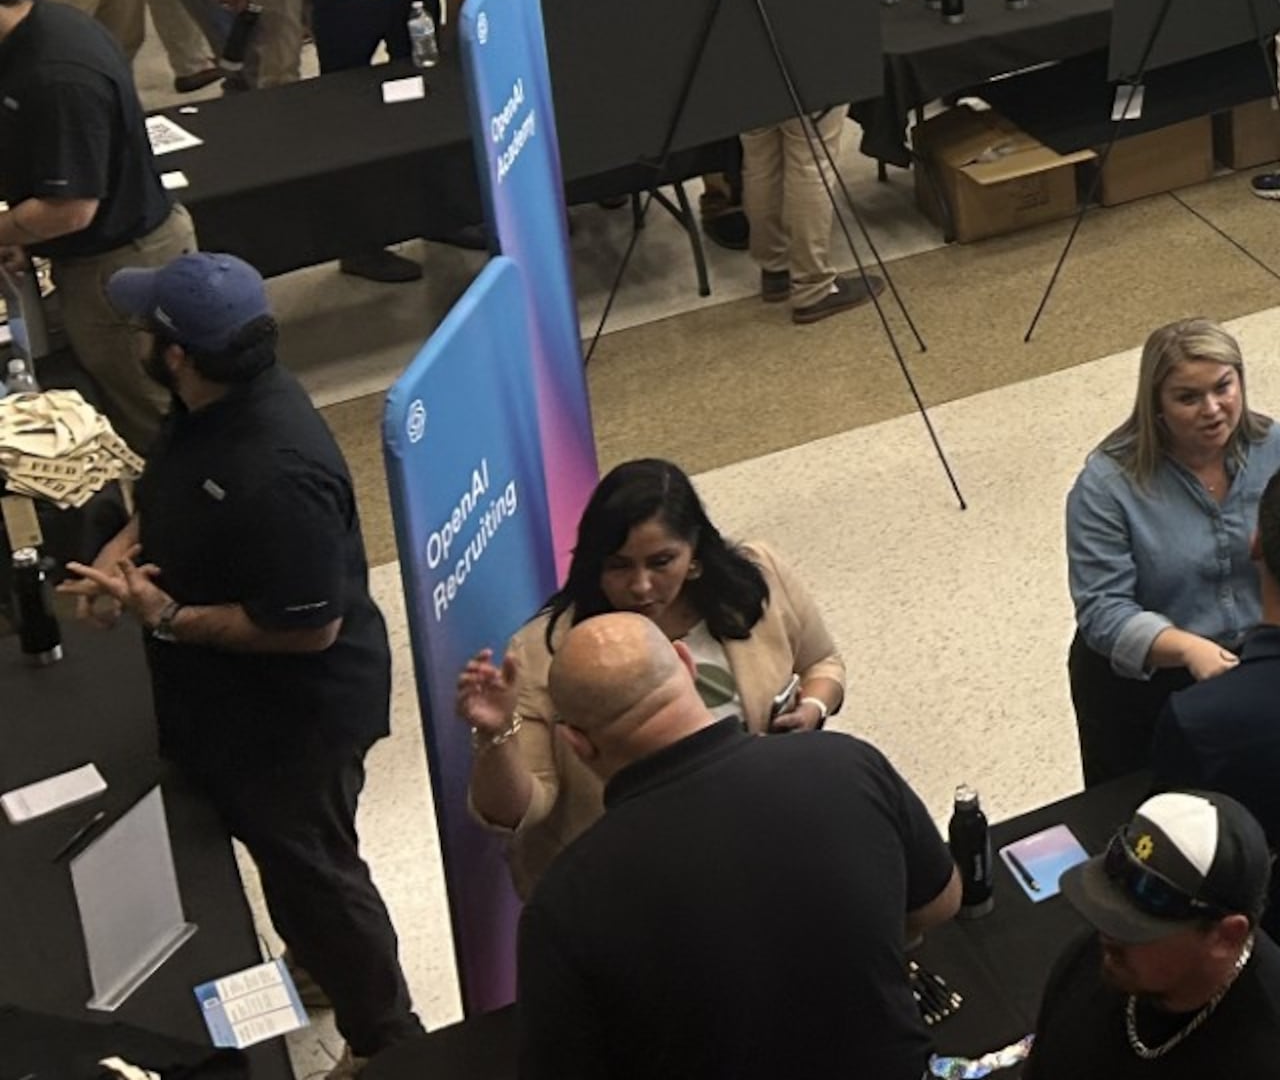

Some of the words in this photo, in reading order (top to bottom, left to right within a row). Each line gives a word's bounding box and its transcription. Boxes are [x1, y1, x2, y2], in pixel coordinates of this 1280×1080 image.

[491, 77, 525, 143] OpenAI
[497, 108, 536, 184] Academy
[31, 461, 77, 476] FEED
[426, 457, 489, 570] OpenAI
[433, 480, 518, 622] Recruiting
